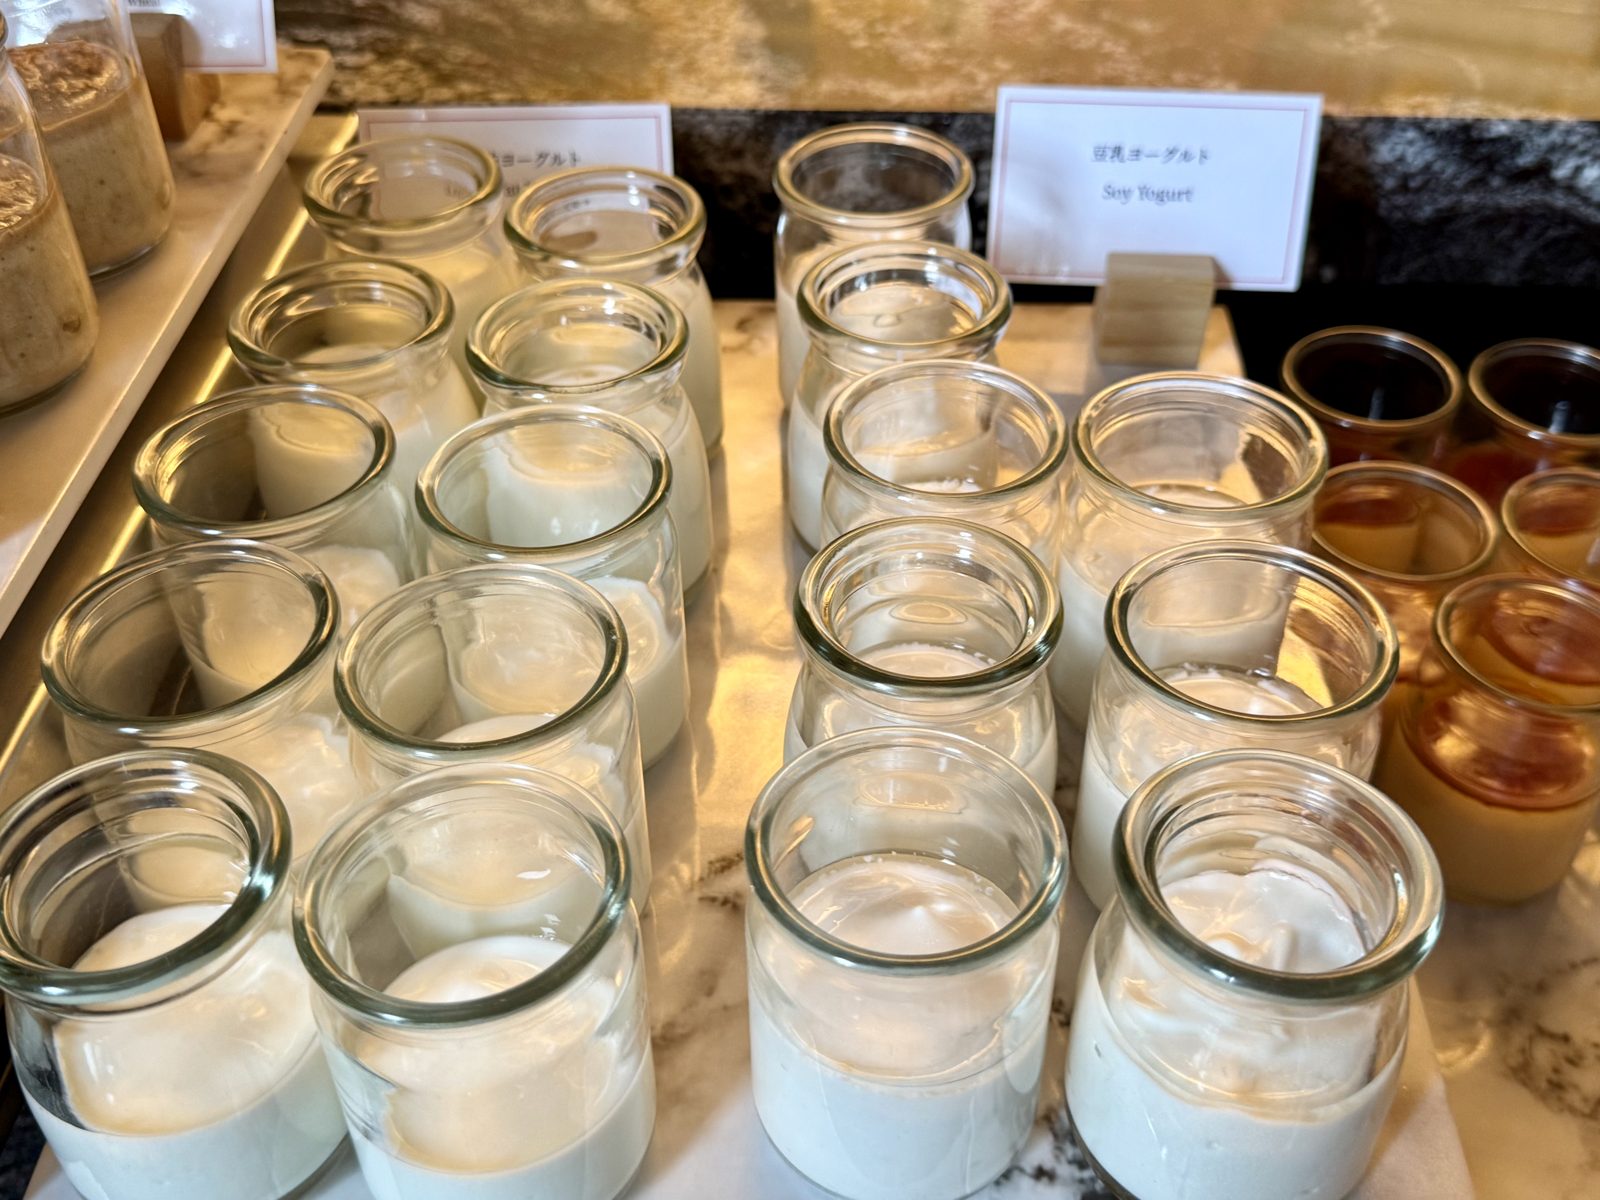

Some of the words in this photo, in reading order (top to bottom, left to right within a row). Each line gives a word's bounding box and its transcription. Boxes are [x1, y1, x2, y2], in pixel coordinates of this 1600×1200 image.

[1092, 145, 1209, 164] 豆乳ヨーグルト
[1102, 184, 1132, 205] Soy
[1138, 184, 1194, 206] Yogurt
